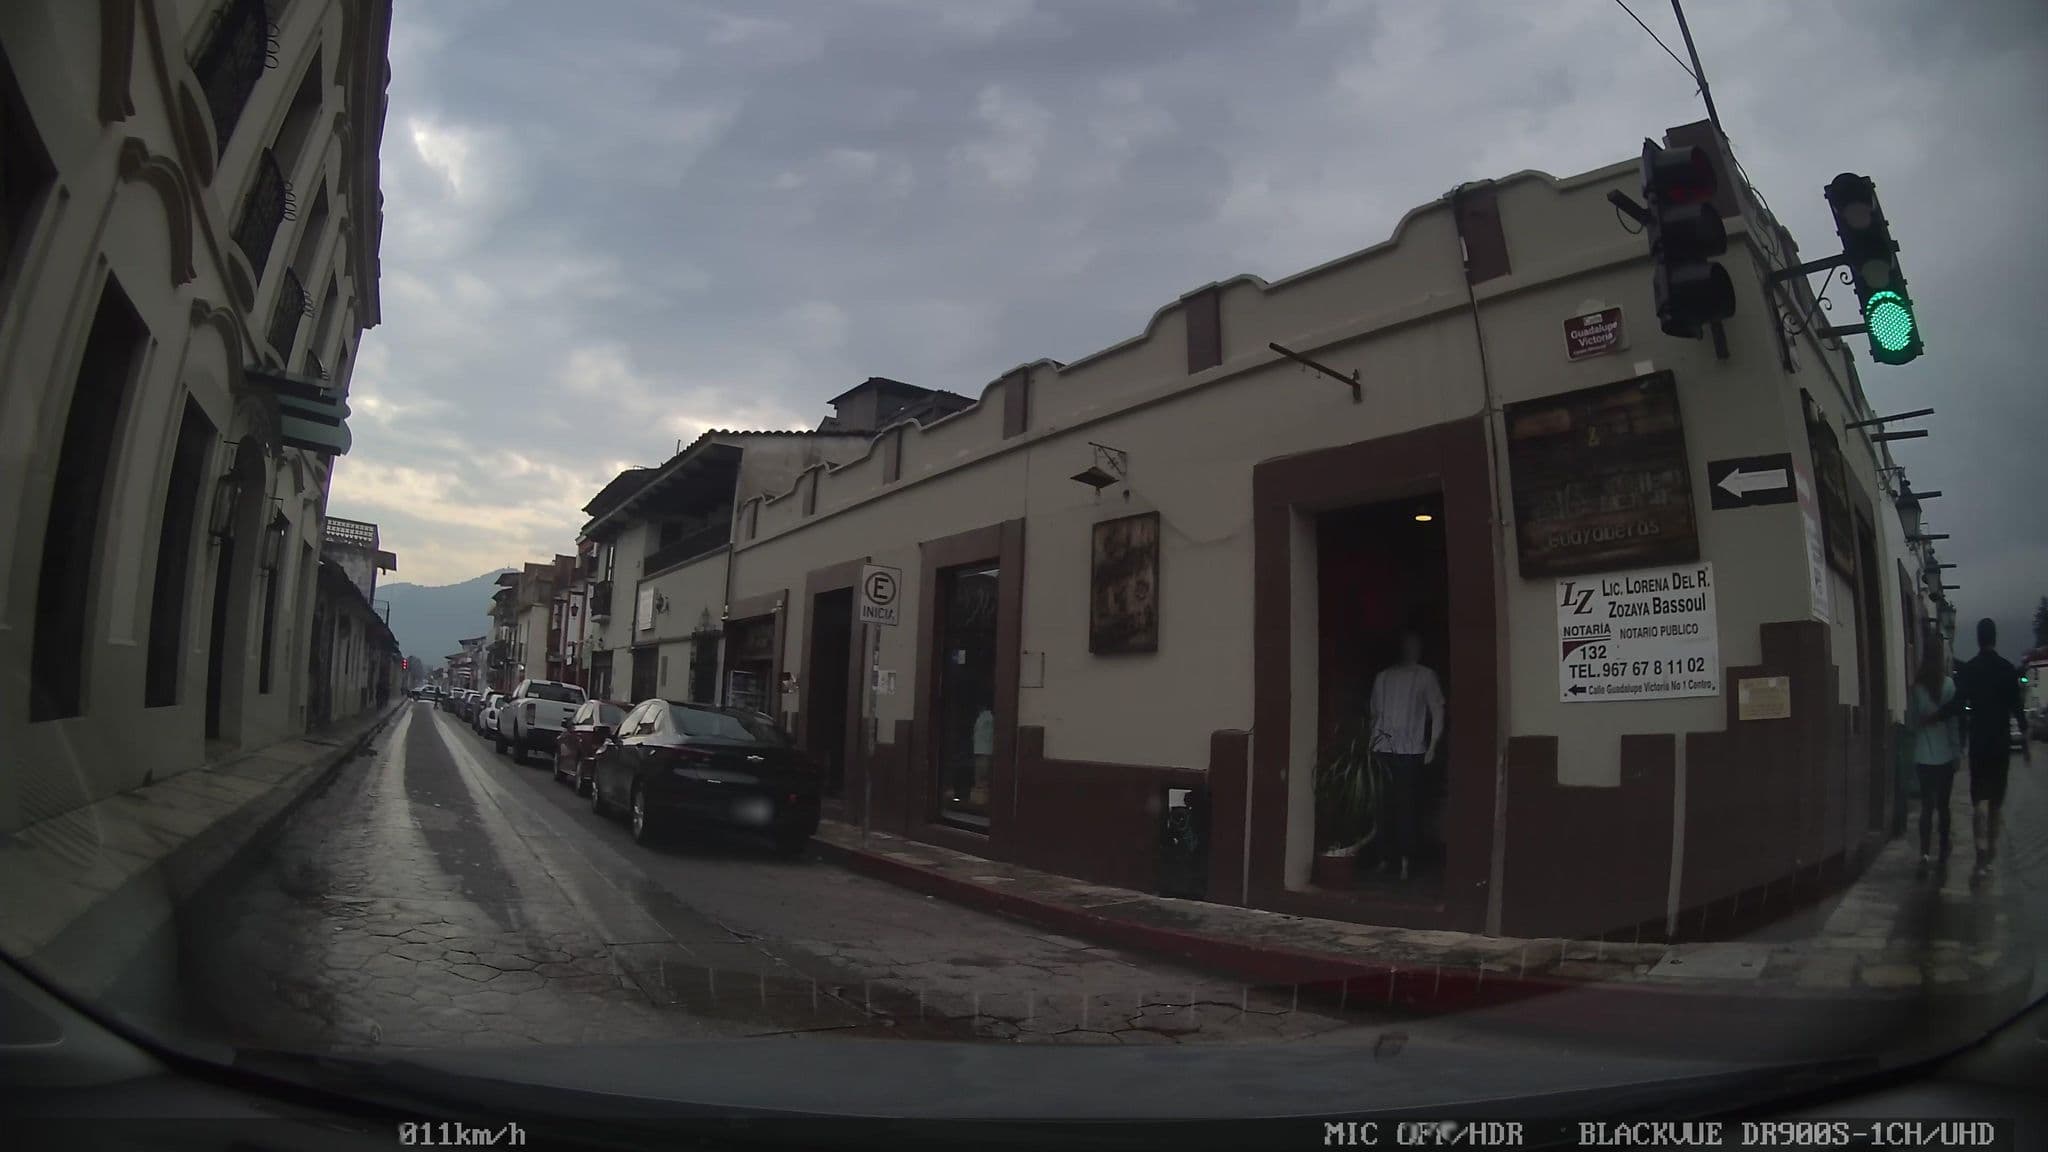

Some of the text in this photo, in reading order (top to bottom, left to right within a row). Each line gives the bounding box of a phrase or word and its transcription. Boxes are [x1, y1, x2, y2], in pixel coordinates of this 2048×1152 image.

[1571, 321, 1618, 339] Guadalupe
[1578, 333, 1613, 346] Victoria
[873, 577, 889, 600] E
[1560, 582, 1595, 615] LZ
[1652, 592, 1706, 614] Bassoul
[863, 605, 895, 620] INICIA
[1620, 623, 1699, 640] NOTARIO PUBLICO
[1580, 645, 1607, 660] 132
[1632, 661, 1649, 676] 67
[1654, 660, 1662, 675] 8
[1668, 659, 1682, 674] 11
[1687, 657, 1705, 672] 02
